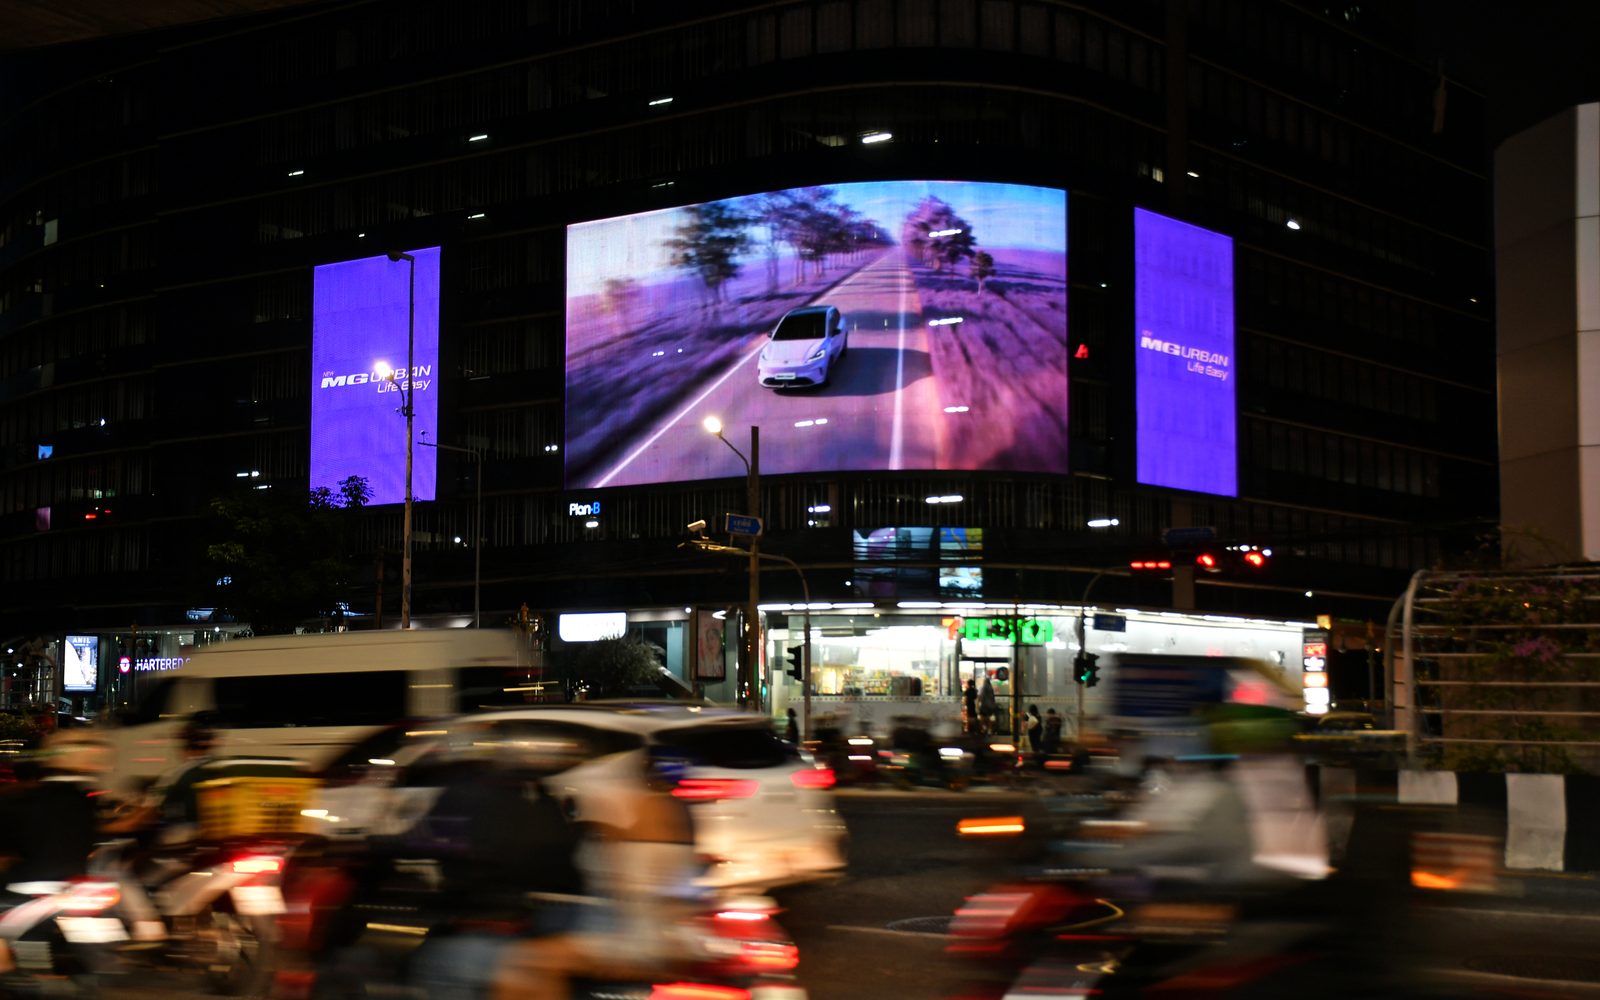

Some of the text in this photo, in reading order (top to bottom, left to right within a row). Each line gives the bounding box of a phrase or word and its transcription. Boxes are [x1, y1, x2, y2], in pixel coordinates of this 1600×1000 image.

[1140, 336, 1229, 367] MG URBAN
[1187, 361, 1229, 381] Life Easy
[321, 373, 369, 389] MG
[377, 382, 398, 393] Life
[134, 657, 184, 671] HARTERED
